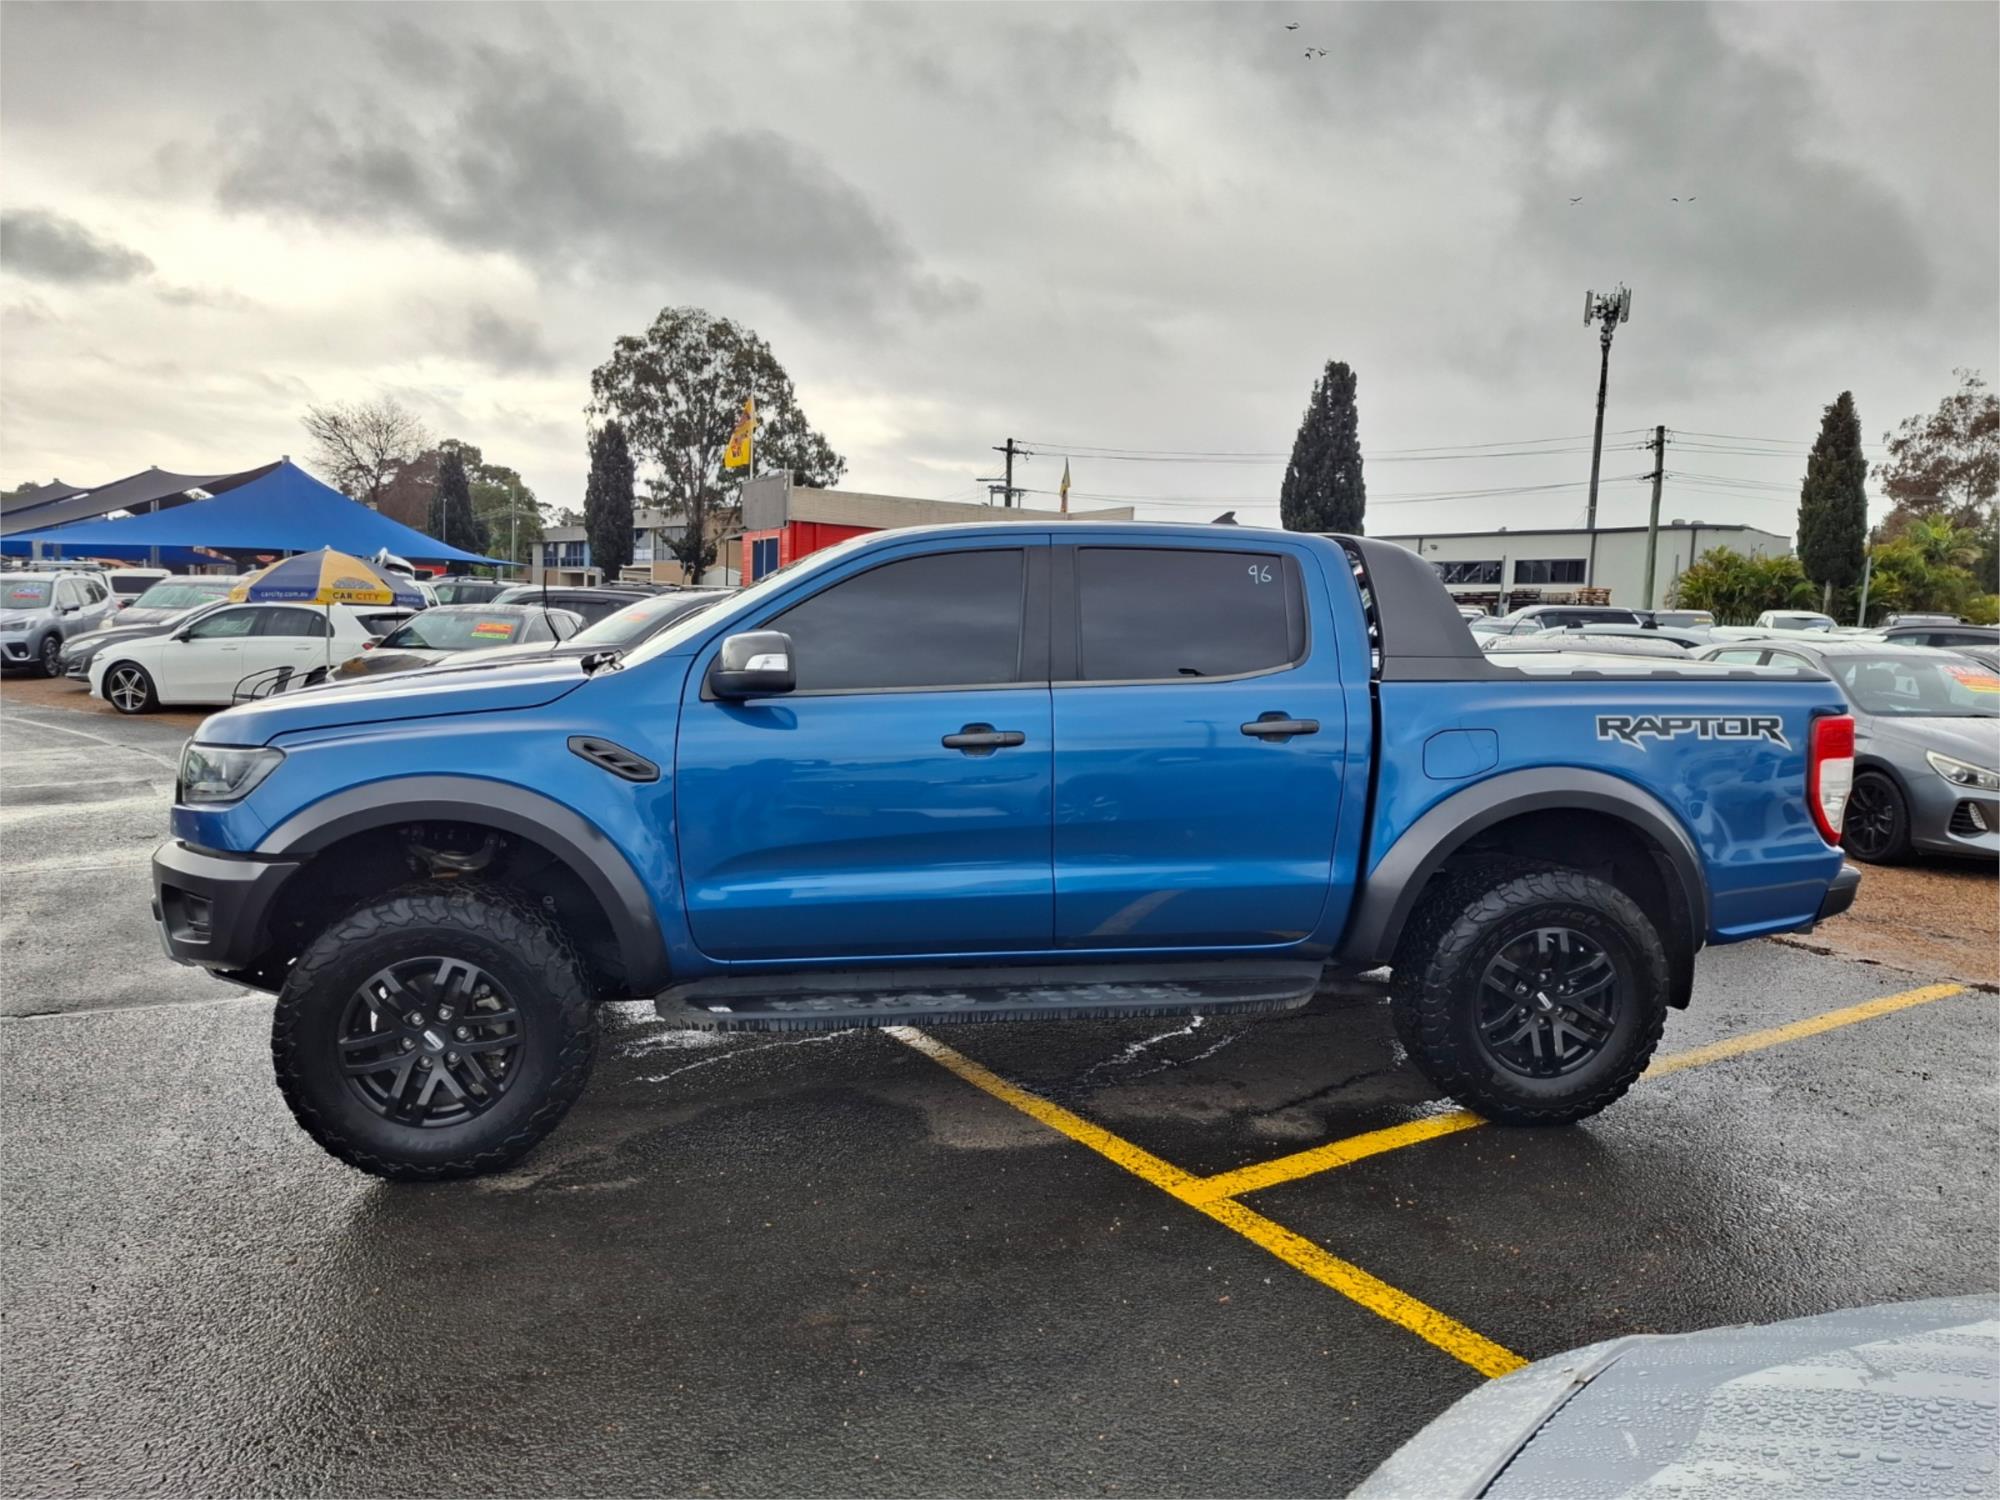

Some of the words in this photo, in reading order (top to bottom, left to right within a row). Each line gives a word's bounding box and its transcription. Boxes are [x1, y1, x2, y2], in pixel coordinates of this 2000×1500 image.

[1247, 564, 1272, 585] 96
[260, 590, 309, 599] carcity.com.au
[332, 591, 353, 600] CAR
[355, 591, 381, 601] CITY
[1595, 714, 1792, 752] RAPTOR
